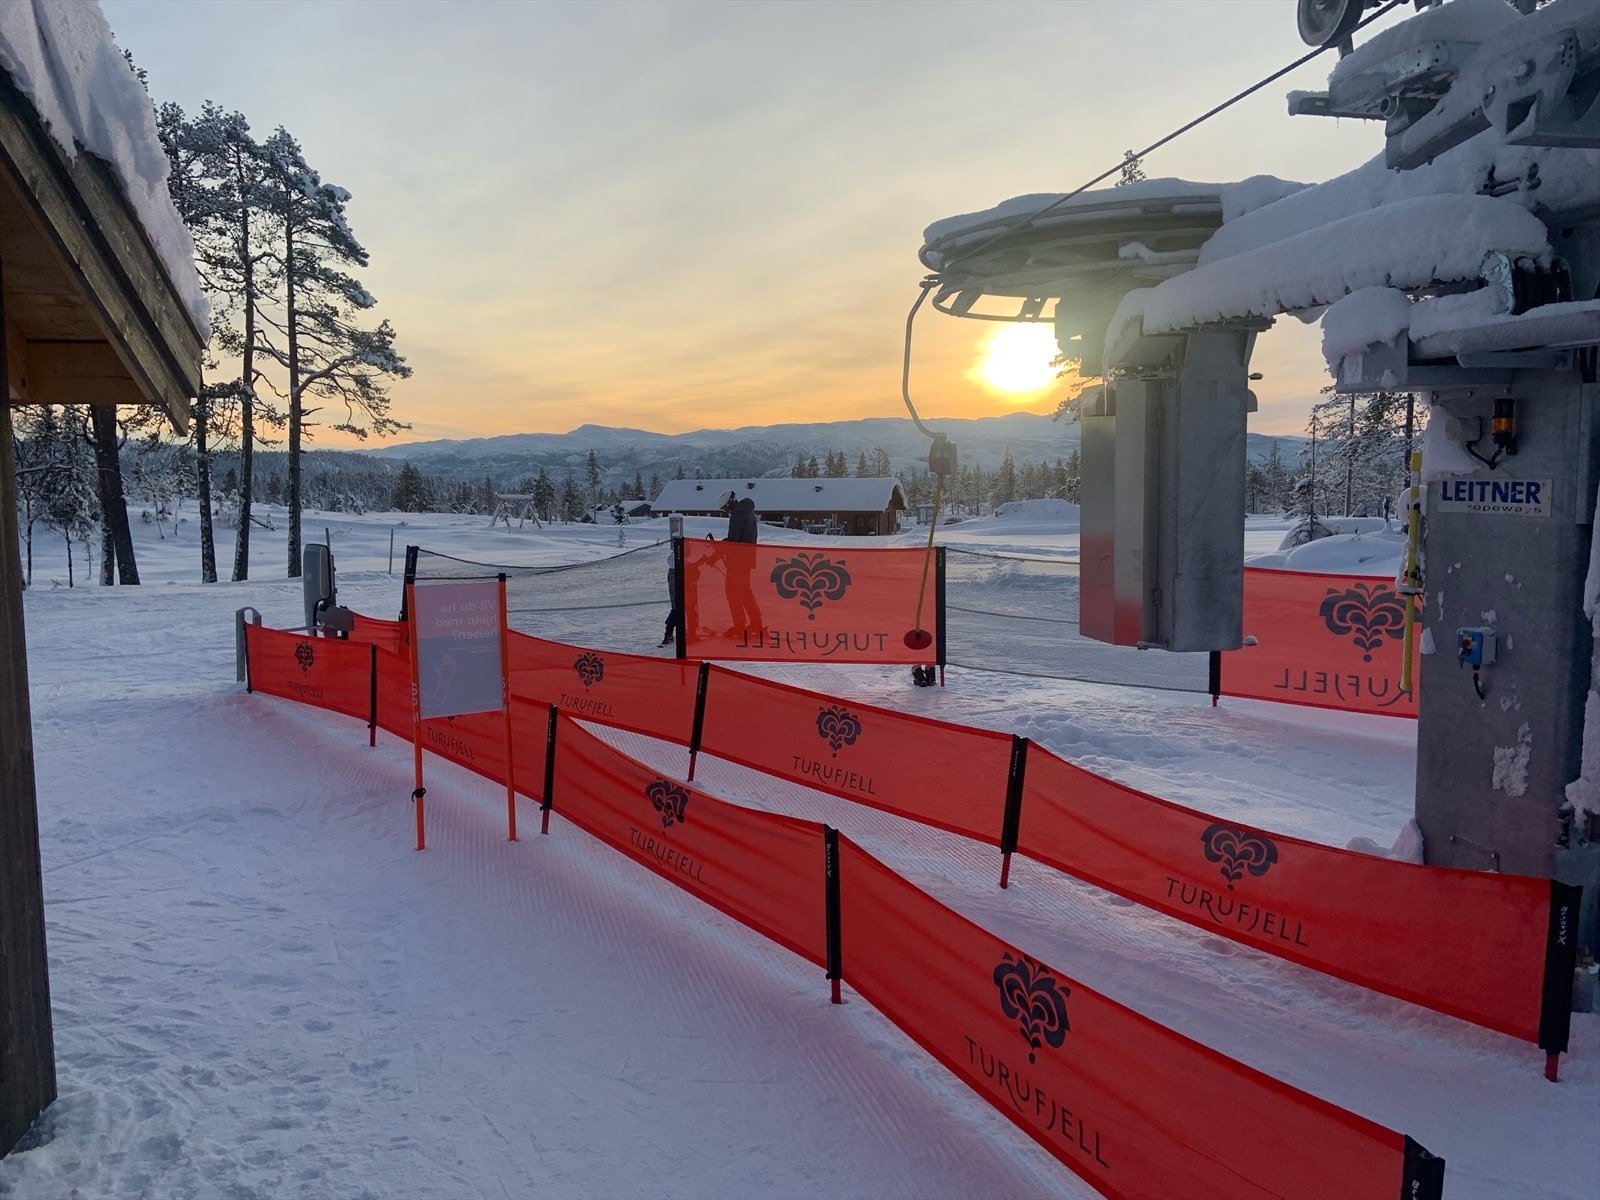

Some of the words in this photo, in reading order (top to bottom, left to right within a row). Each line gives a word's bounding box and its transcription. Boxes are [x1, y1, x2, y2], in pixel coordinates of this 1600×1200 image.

[1442, 481, 1541, 503] LEITNER
[561, 693, 615, 718] TURUFJELL
[426, 726, 476, 760] TURUFJELL
[793, 755, 875, 795] TURUFJELL
[629, 827, 704, 884] TURUFJELL
[1166, 875, 1308, 949] TURUFJELL
[965, 1036, 1108, 1168] TURUFJELL
